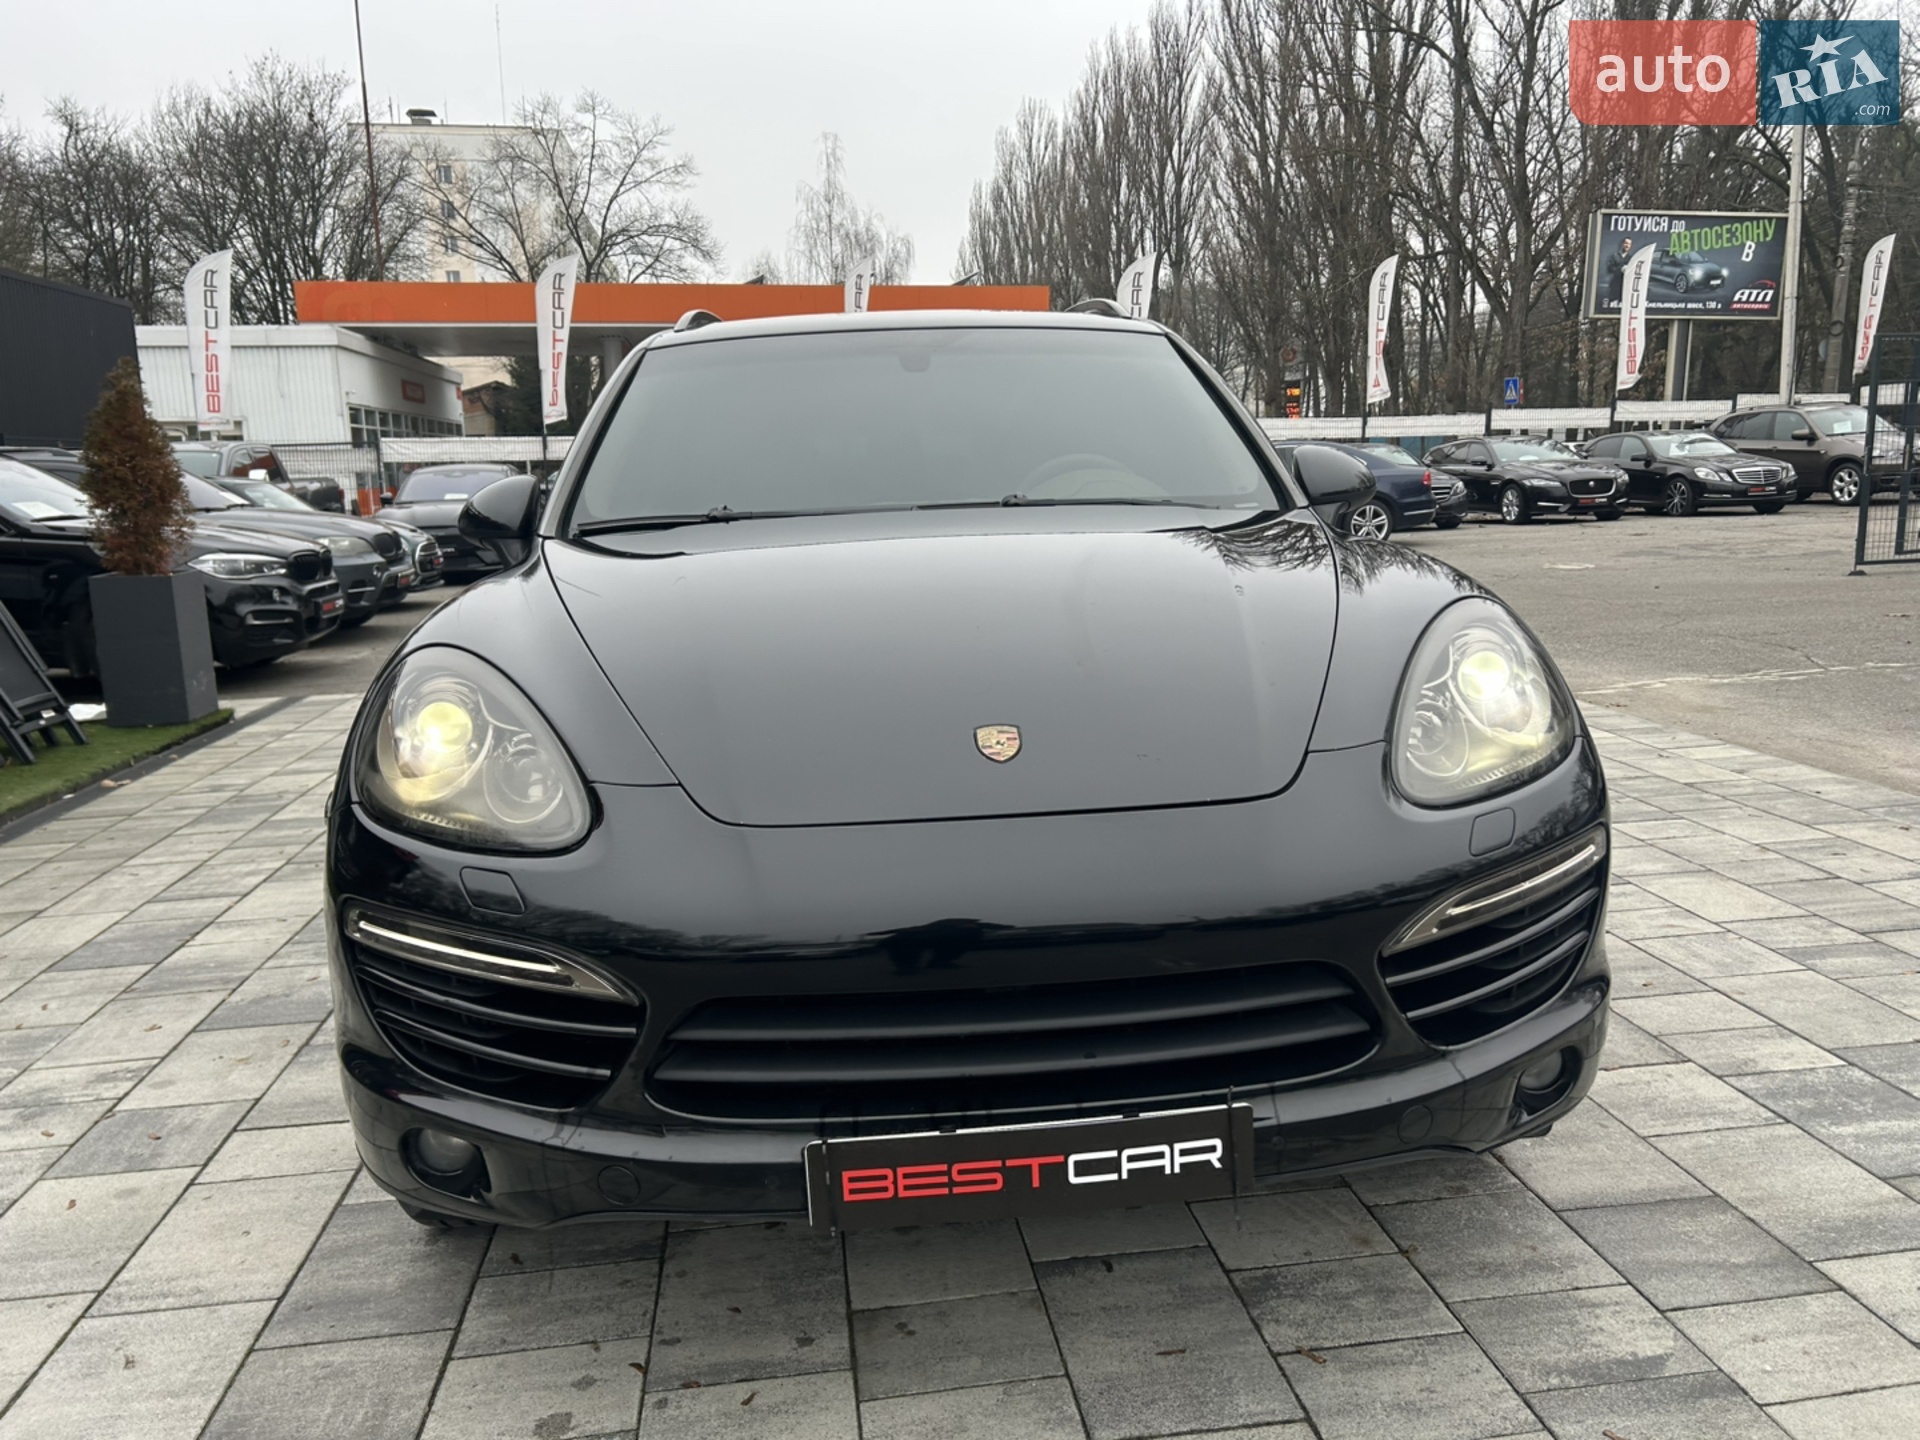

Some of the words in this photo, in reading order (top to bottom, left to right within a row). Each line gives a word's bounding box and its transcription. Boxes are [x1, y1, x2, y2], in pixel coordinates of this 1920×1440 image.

[1669, 219, 1777, 256] АВТОСЕЗОНУ
[203, 268, 221, 413] BESTCAR
[1626, 260, 1645, 375] BESTCAR
[841, 1137, 1224, 1202] BESTCAR
